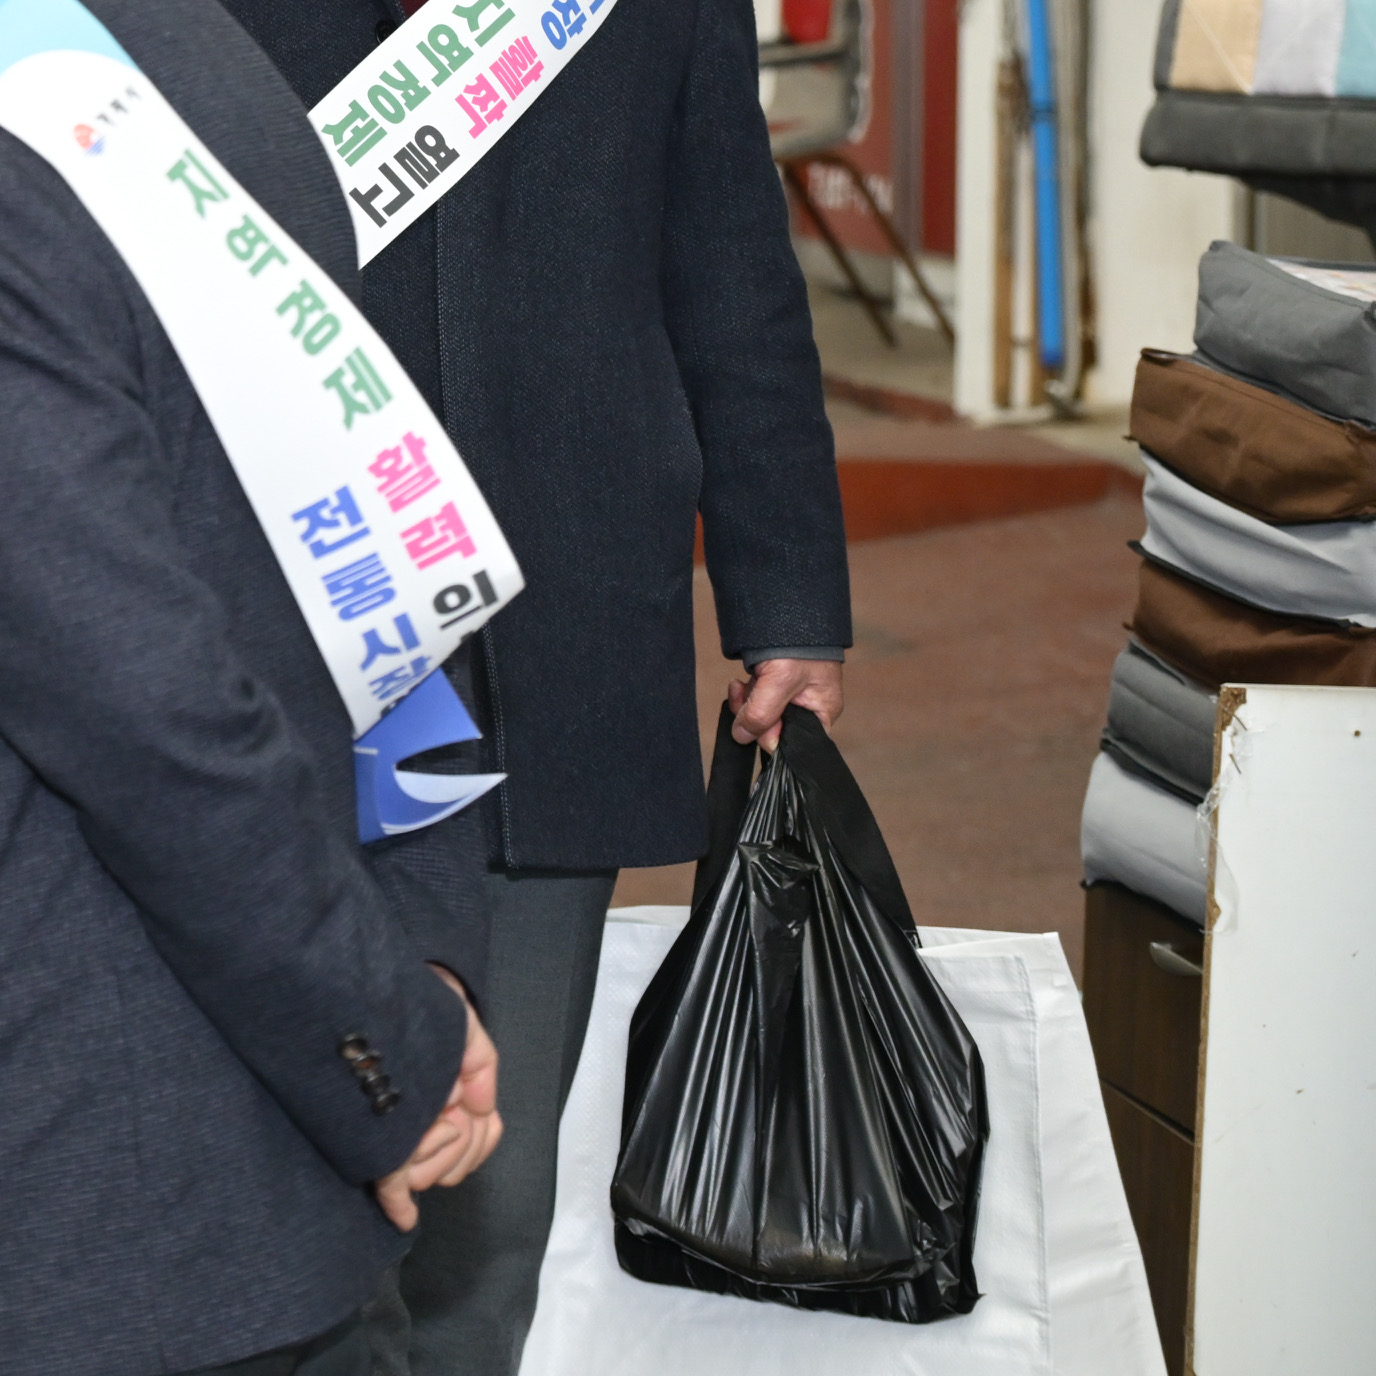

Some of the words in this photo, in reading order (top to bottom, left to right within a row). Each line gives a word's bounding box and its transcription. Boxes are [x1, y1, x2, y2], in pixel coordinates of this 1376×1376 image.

[453, 34, 546, 141] 활짝
[347, 124, 461, 229] 열고
[165, 147, 395, 431] 지역경제
[366, 429, 501, 631] 활력의
